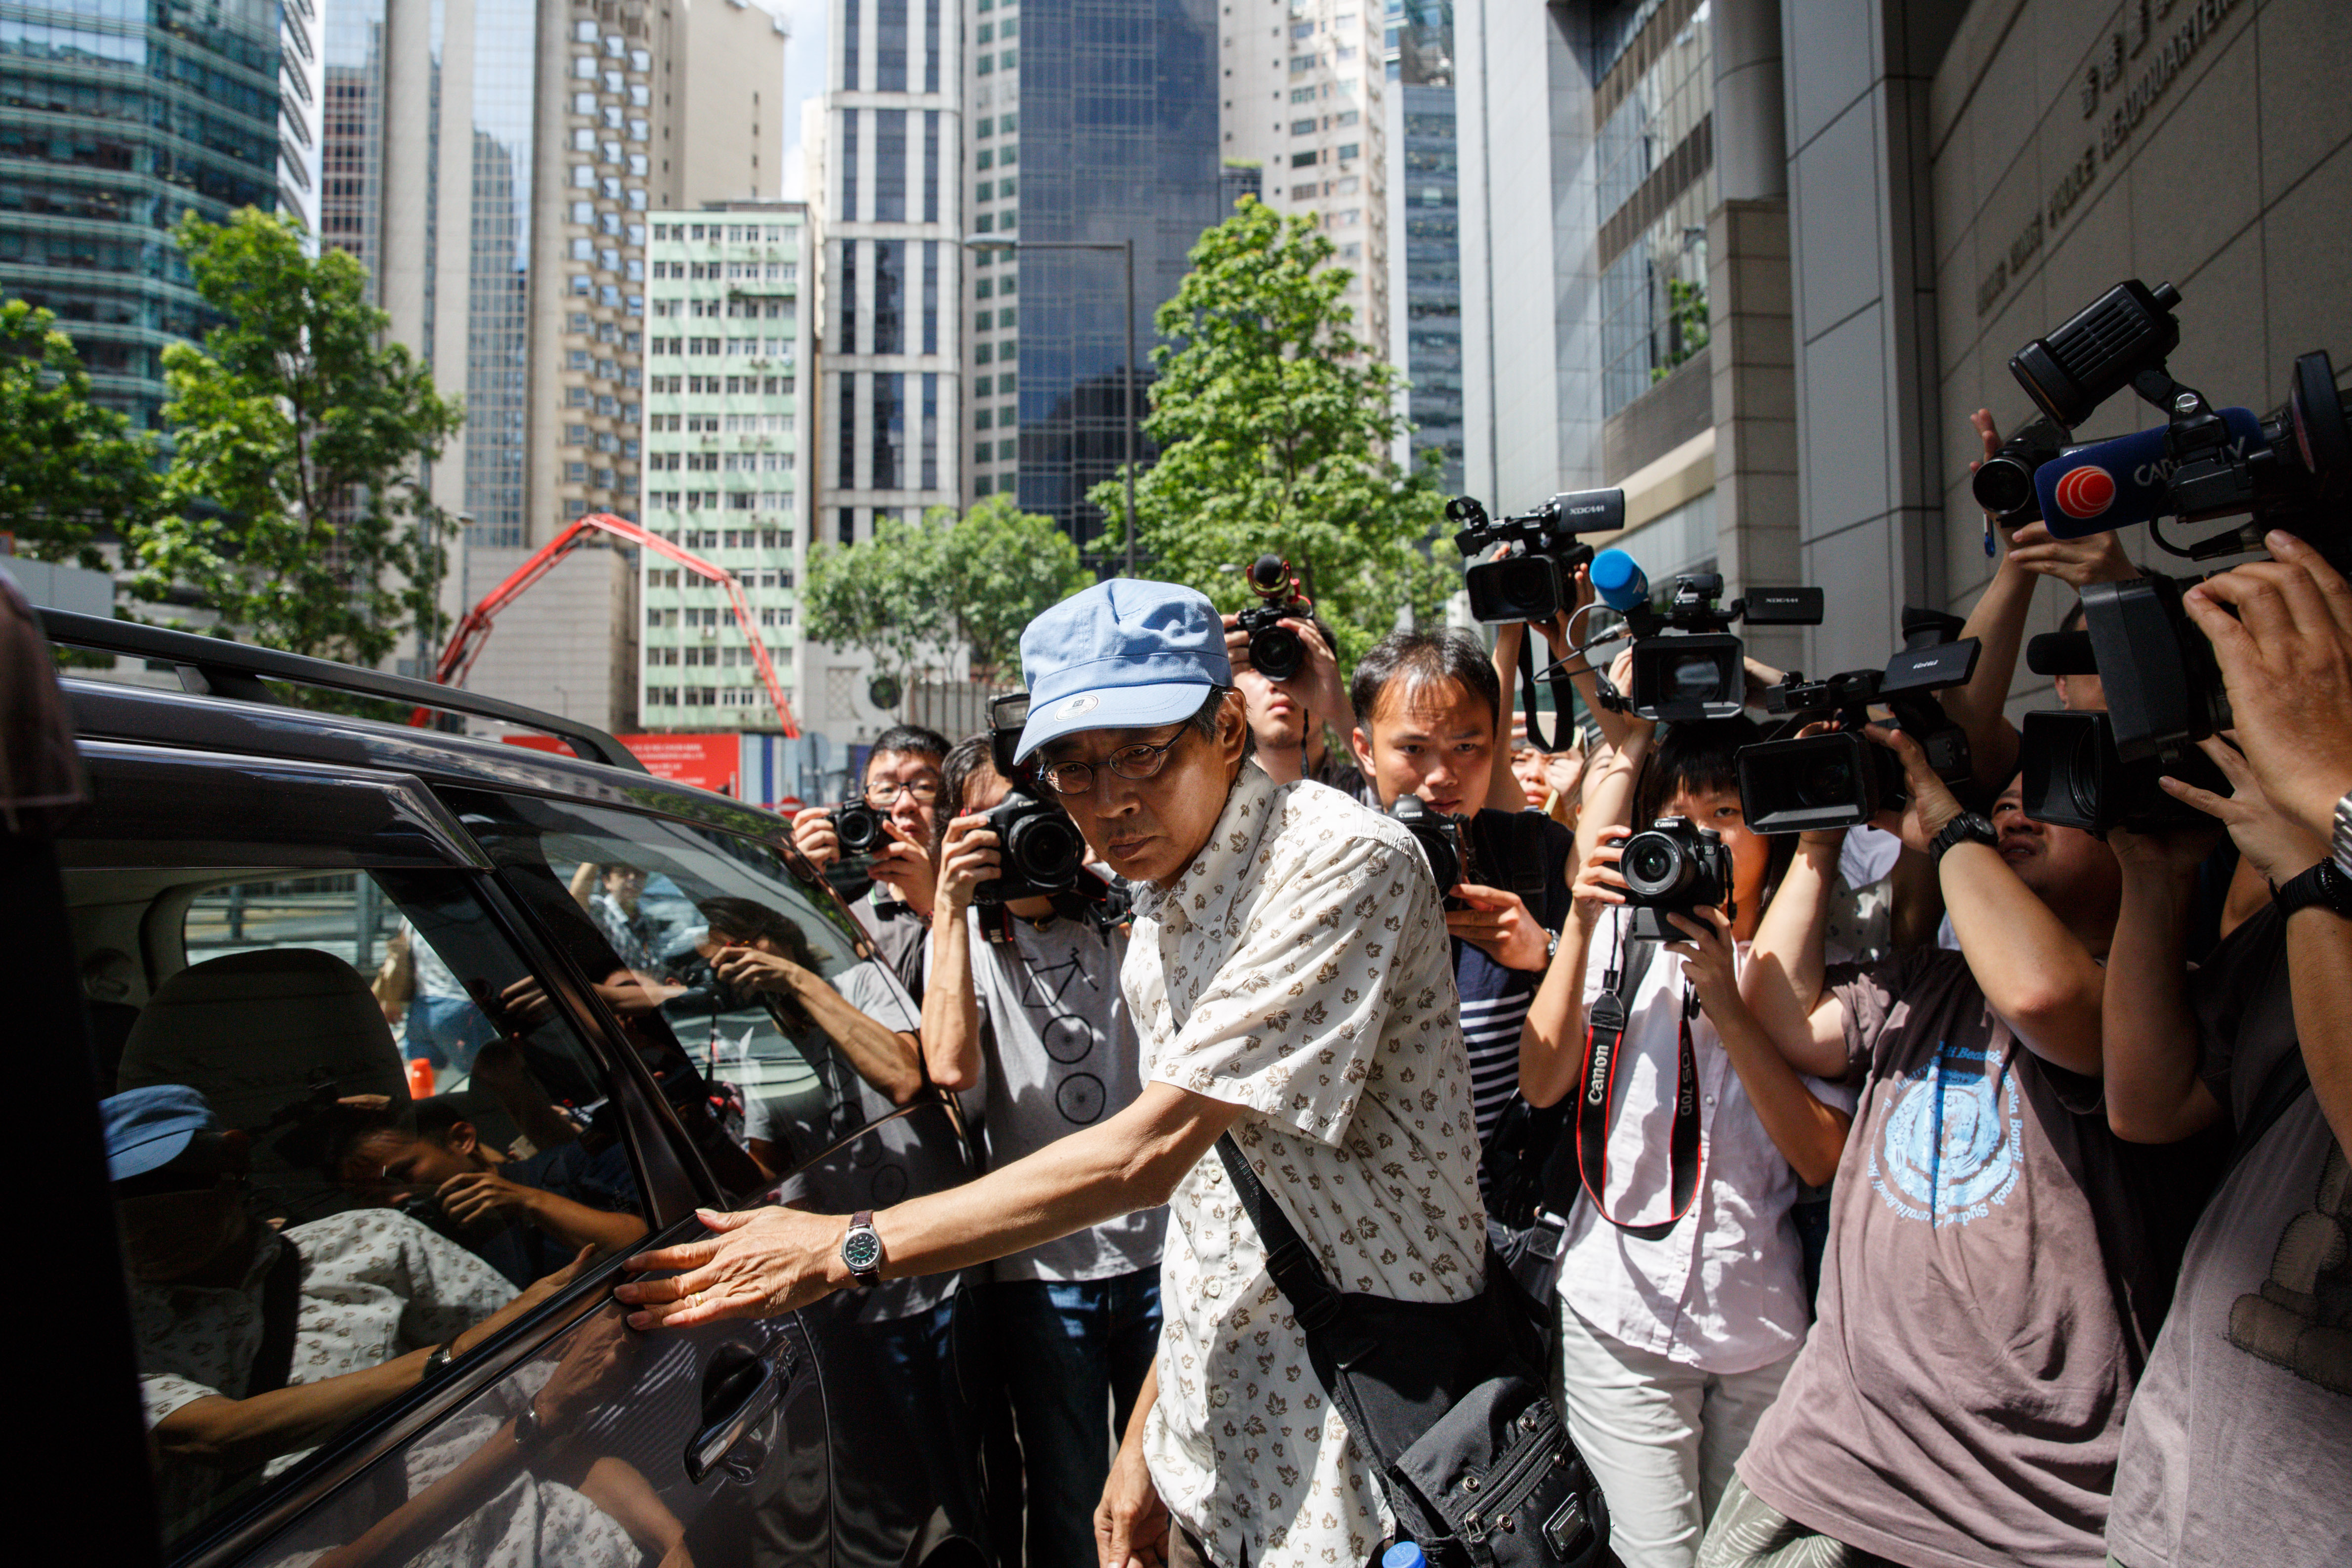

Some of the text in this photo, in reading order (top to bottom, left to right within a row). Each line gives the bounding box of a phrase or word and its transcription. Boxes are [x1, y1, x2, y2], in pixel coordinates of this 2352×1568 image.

[1588, 1045, 1609, 1106] Canon
[1680, 1039, 1693, 1116] EOS 70D
[2009, 1117, 2024, 1163] Bondi
[1871, 1180, 1899, 1209] Bondi
[1990, 1166, 2020, 1206] Beach
